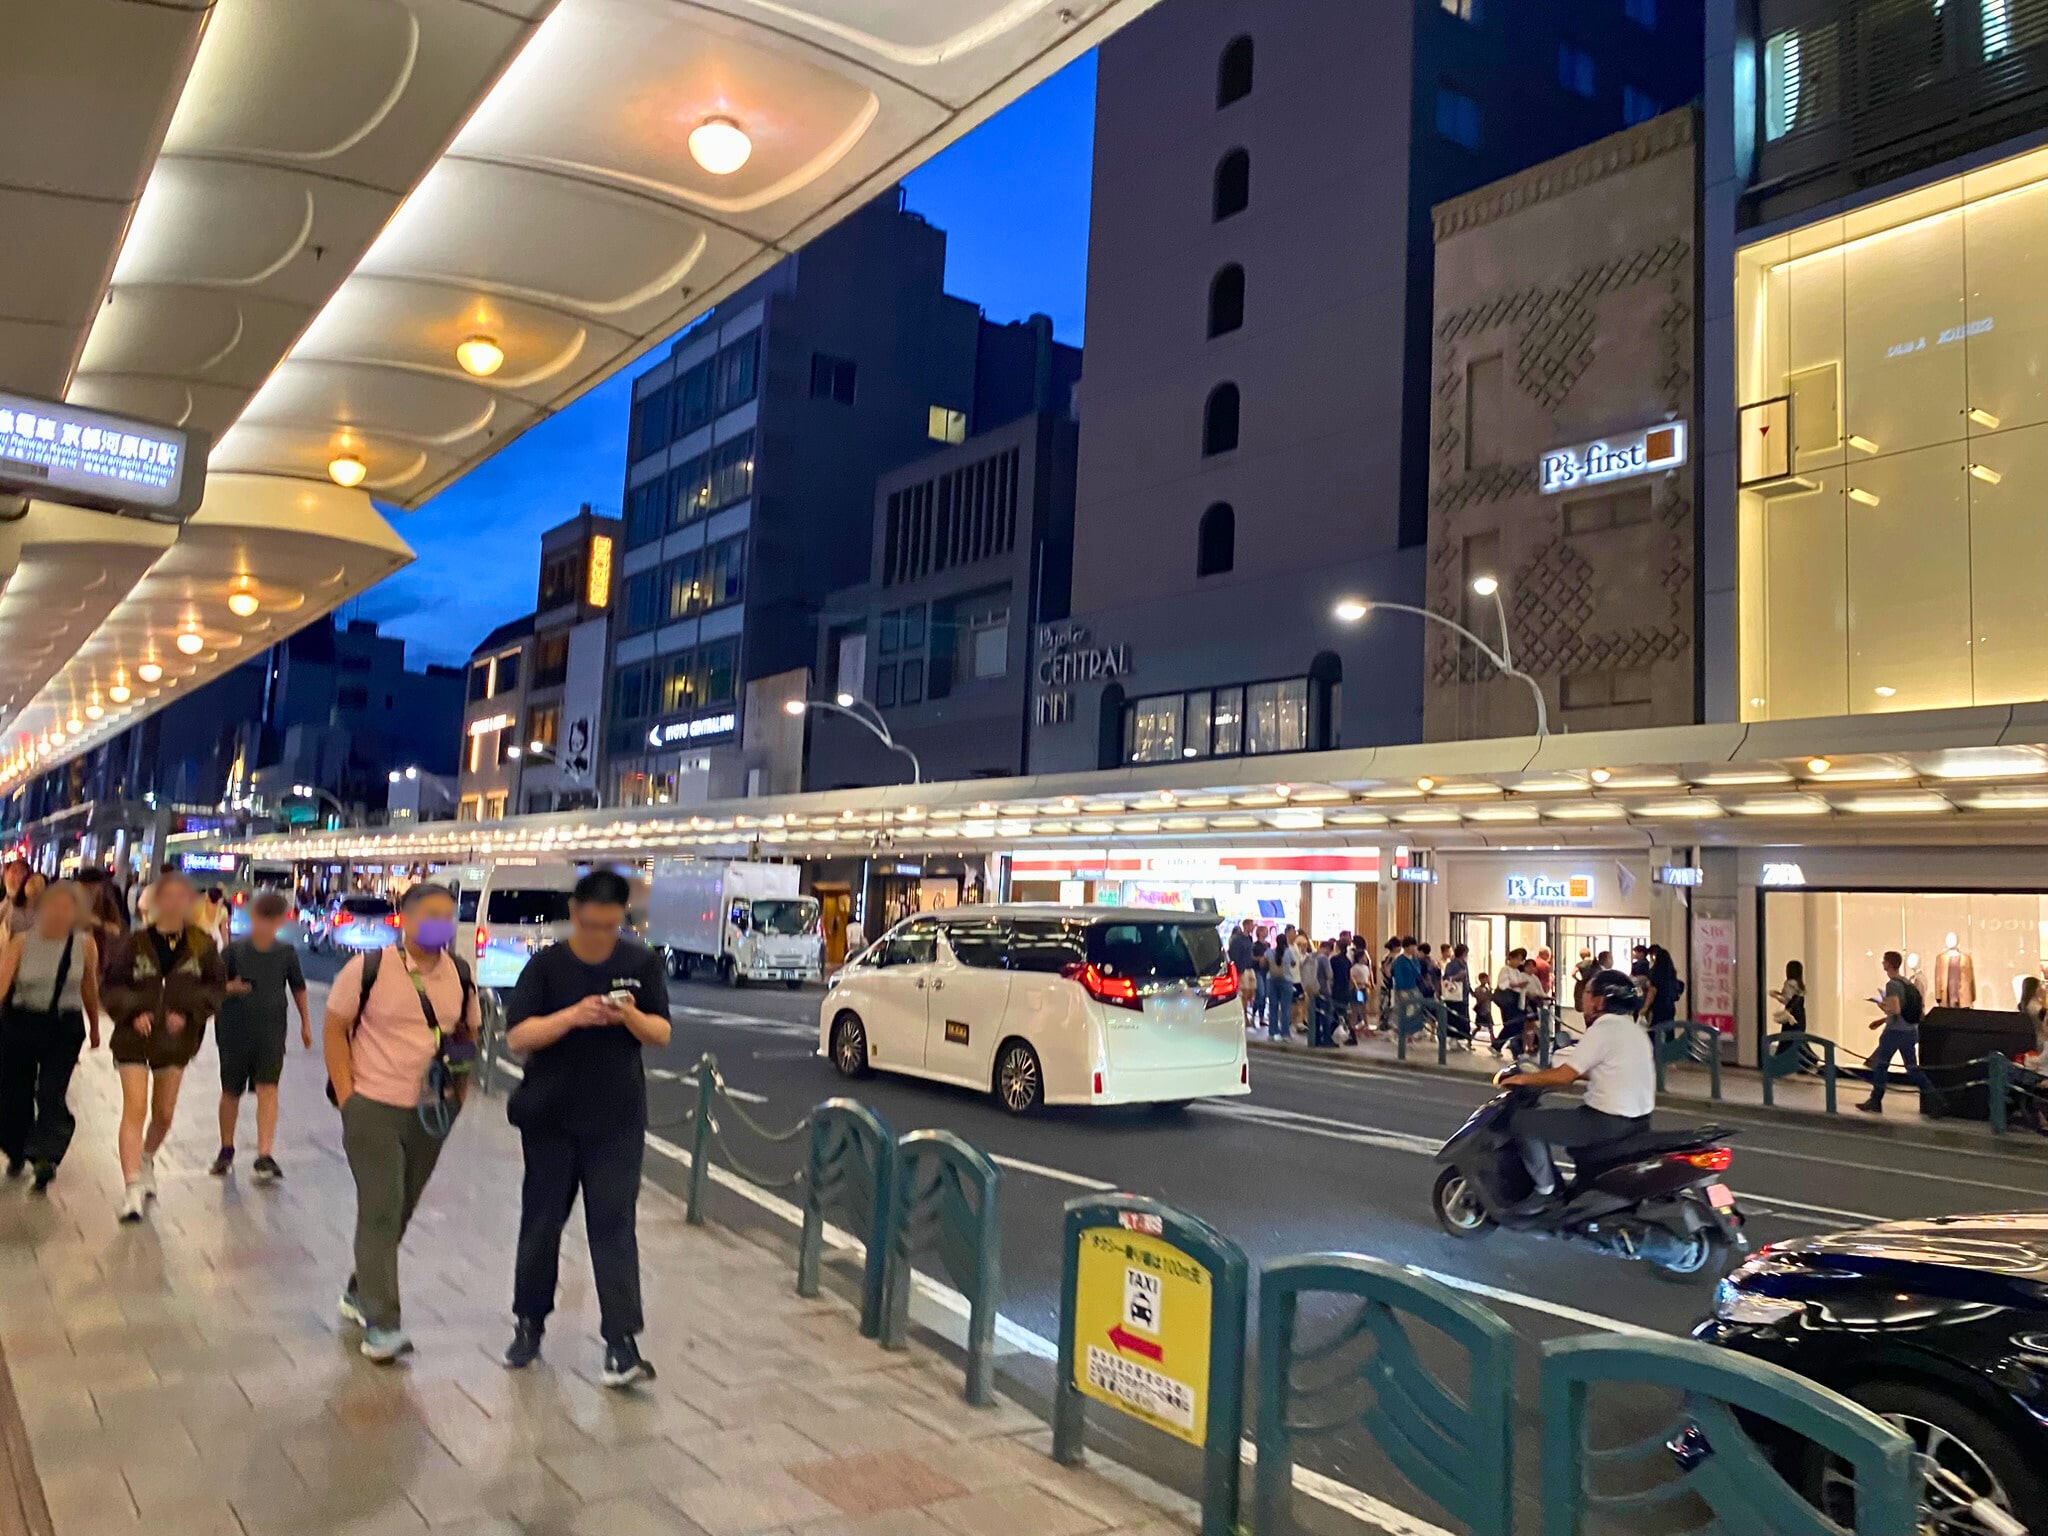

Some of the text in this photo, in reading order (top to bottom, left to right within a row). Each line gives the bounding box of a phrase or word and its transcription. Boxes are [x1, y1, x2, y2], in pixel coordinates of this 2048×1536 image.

[1542, 444, 1643, 486] P's-first
[1038, 643, 1129, 685] CENTRAL
[1036, 690, 1067, 726] INN
[1128, 1271, 1158, 1295] TAXI
